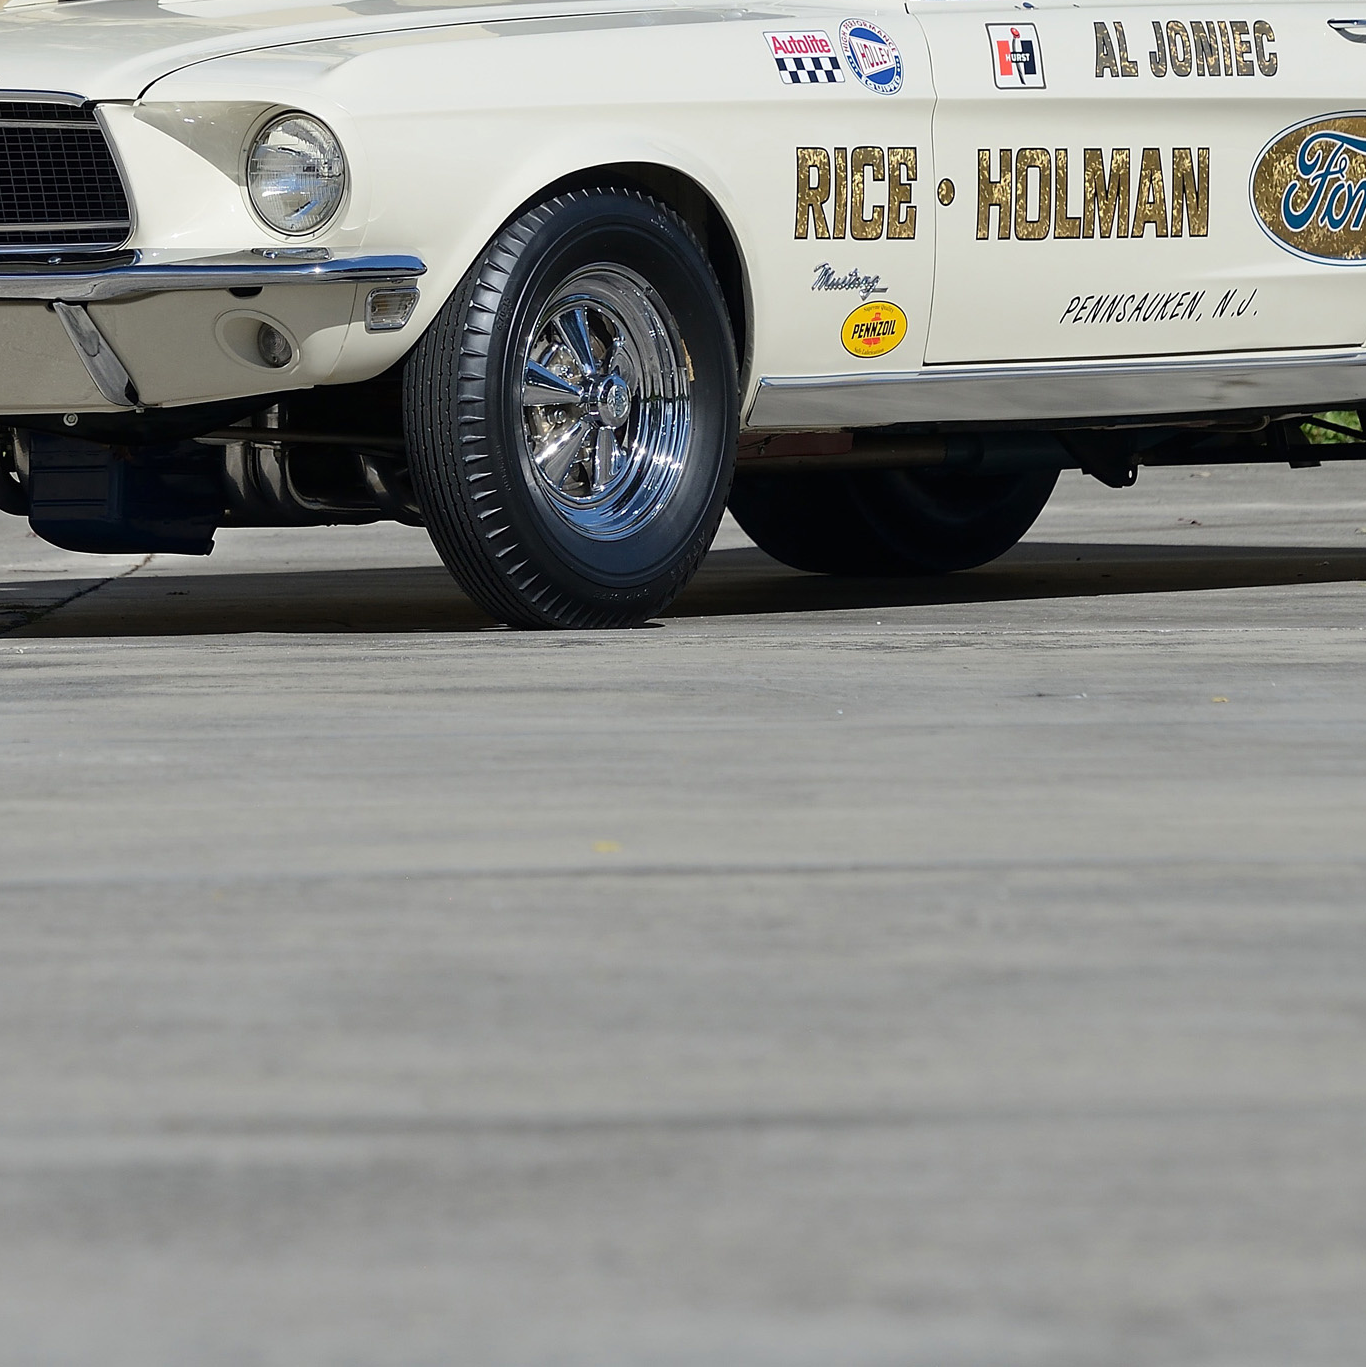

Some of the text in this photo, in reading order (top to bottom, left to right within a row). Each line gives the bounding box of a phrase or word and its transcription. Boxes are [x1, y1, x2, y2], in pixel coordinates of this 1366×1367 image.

[771, 34, 832, 55] Autolite
[841, 20, 898, 53] HIGH PERFORMANCE
[1095, 20, 1278, 77] AL JONIEC
[855, 40, 893, 71] HOLLEY
[1005, 53, 1030, 62] HURST
[794, 146, 1210, 240] RICE HOLMAN
[811, 262, 889, 301] Mustang
[881, 304, 895, 314] Quality
[1059, 289, 1258, 325] PENNSAUKEN, N.J.
[851, 319, 897, 340] PENNZOIL
